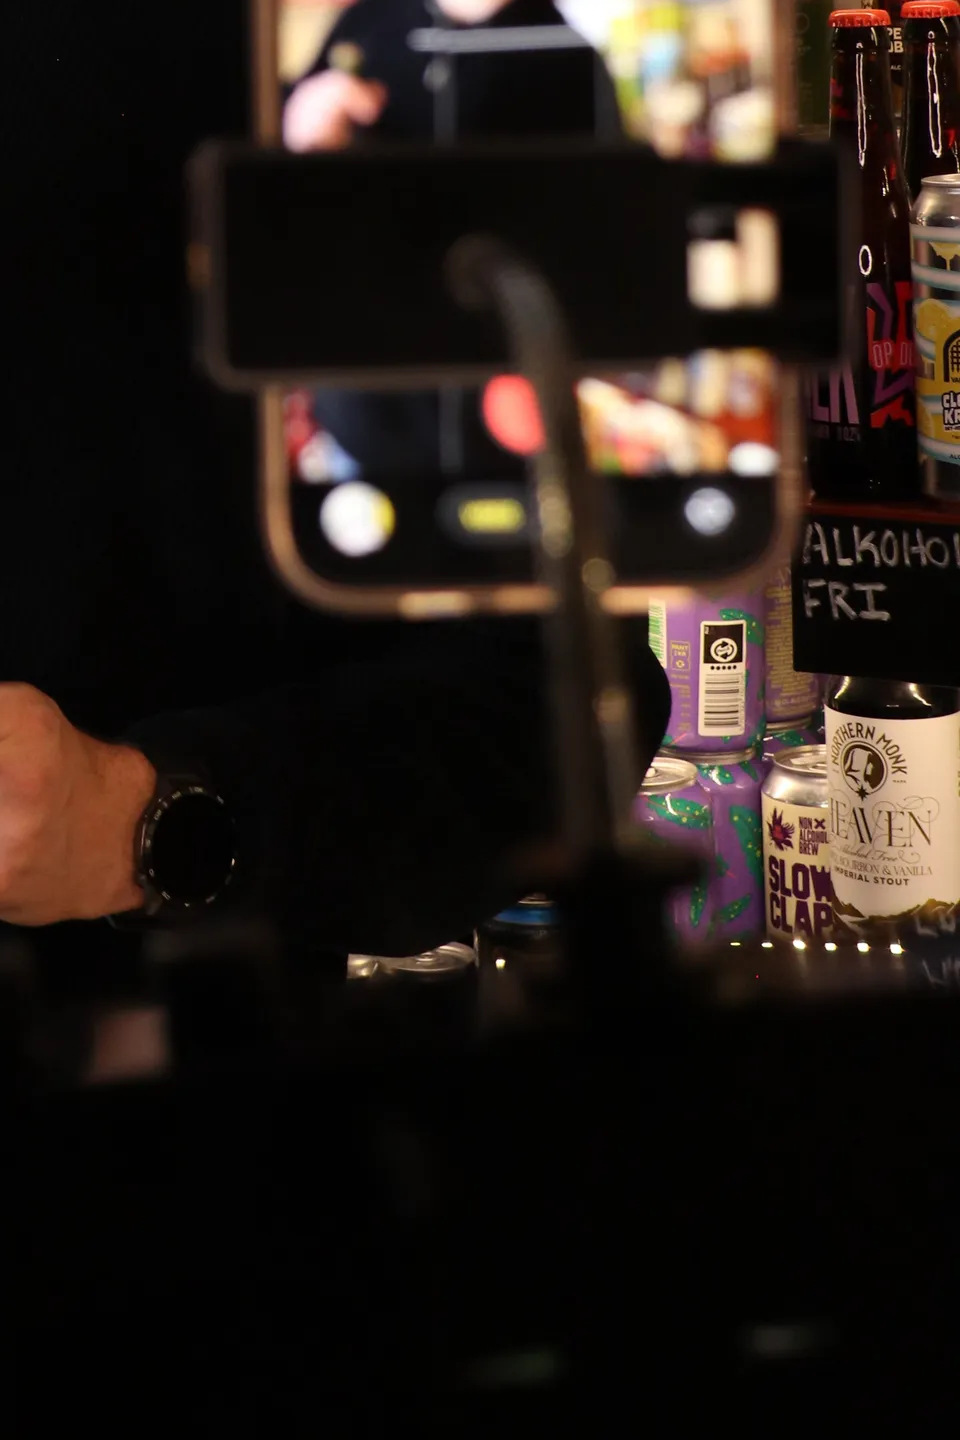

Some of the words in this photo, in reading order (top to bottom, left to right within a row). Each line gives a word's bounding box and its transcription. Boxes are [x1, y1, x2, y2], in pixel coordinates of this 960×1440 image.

[802, 578, 892, 622] FRI
[831, 721, 876, 766] NORTHERN
[876, 732, 908, 775] MONK
[798, 815, 813, 830] NON
[798, 842, 819, 856] BREW
[768, 854, 832, 902] SLOW
[874, 876, 910, 886] STOUT
[892, 865, 934, 877] VANILLA
[769, 891, 835, 938] CLAP
